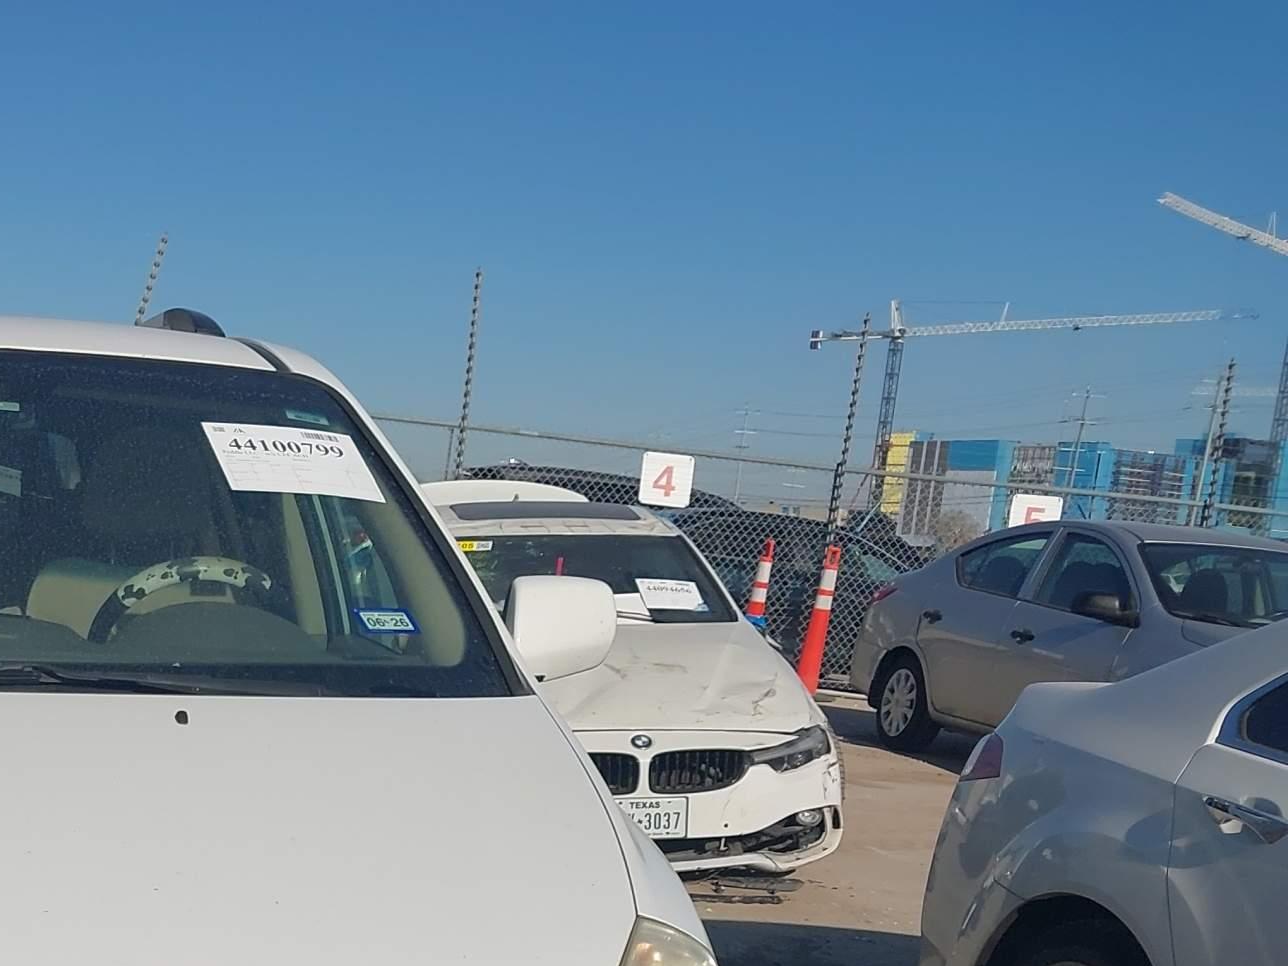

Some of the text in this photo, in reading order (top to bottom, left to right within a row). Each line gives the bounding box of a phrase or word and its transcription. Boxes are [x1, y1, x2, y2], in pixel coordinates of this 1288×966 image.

[228, 438, 344, 458] 44100799
[653, 466, 675, 497] 4
[629, 801, 661, 809] TEXAS
